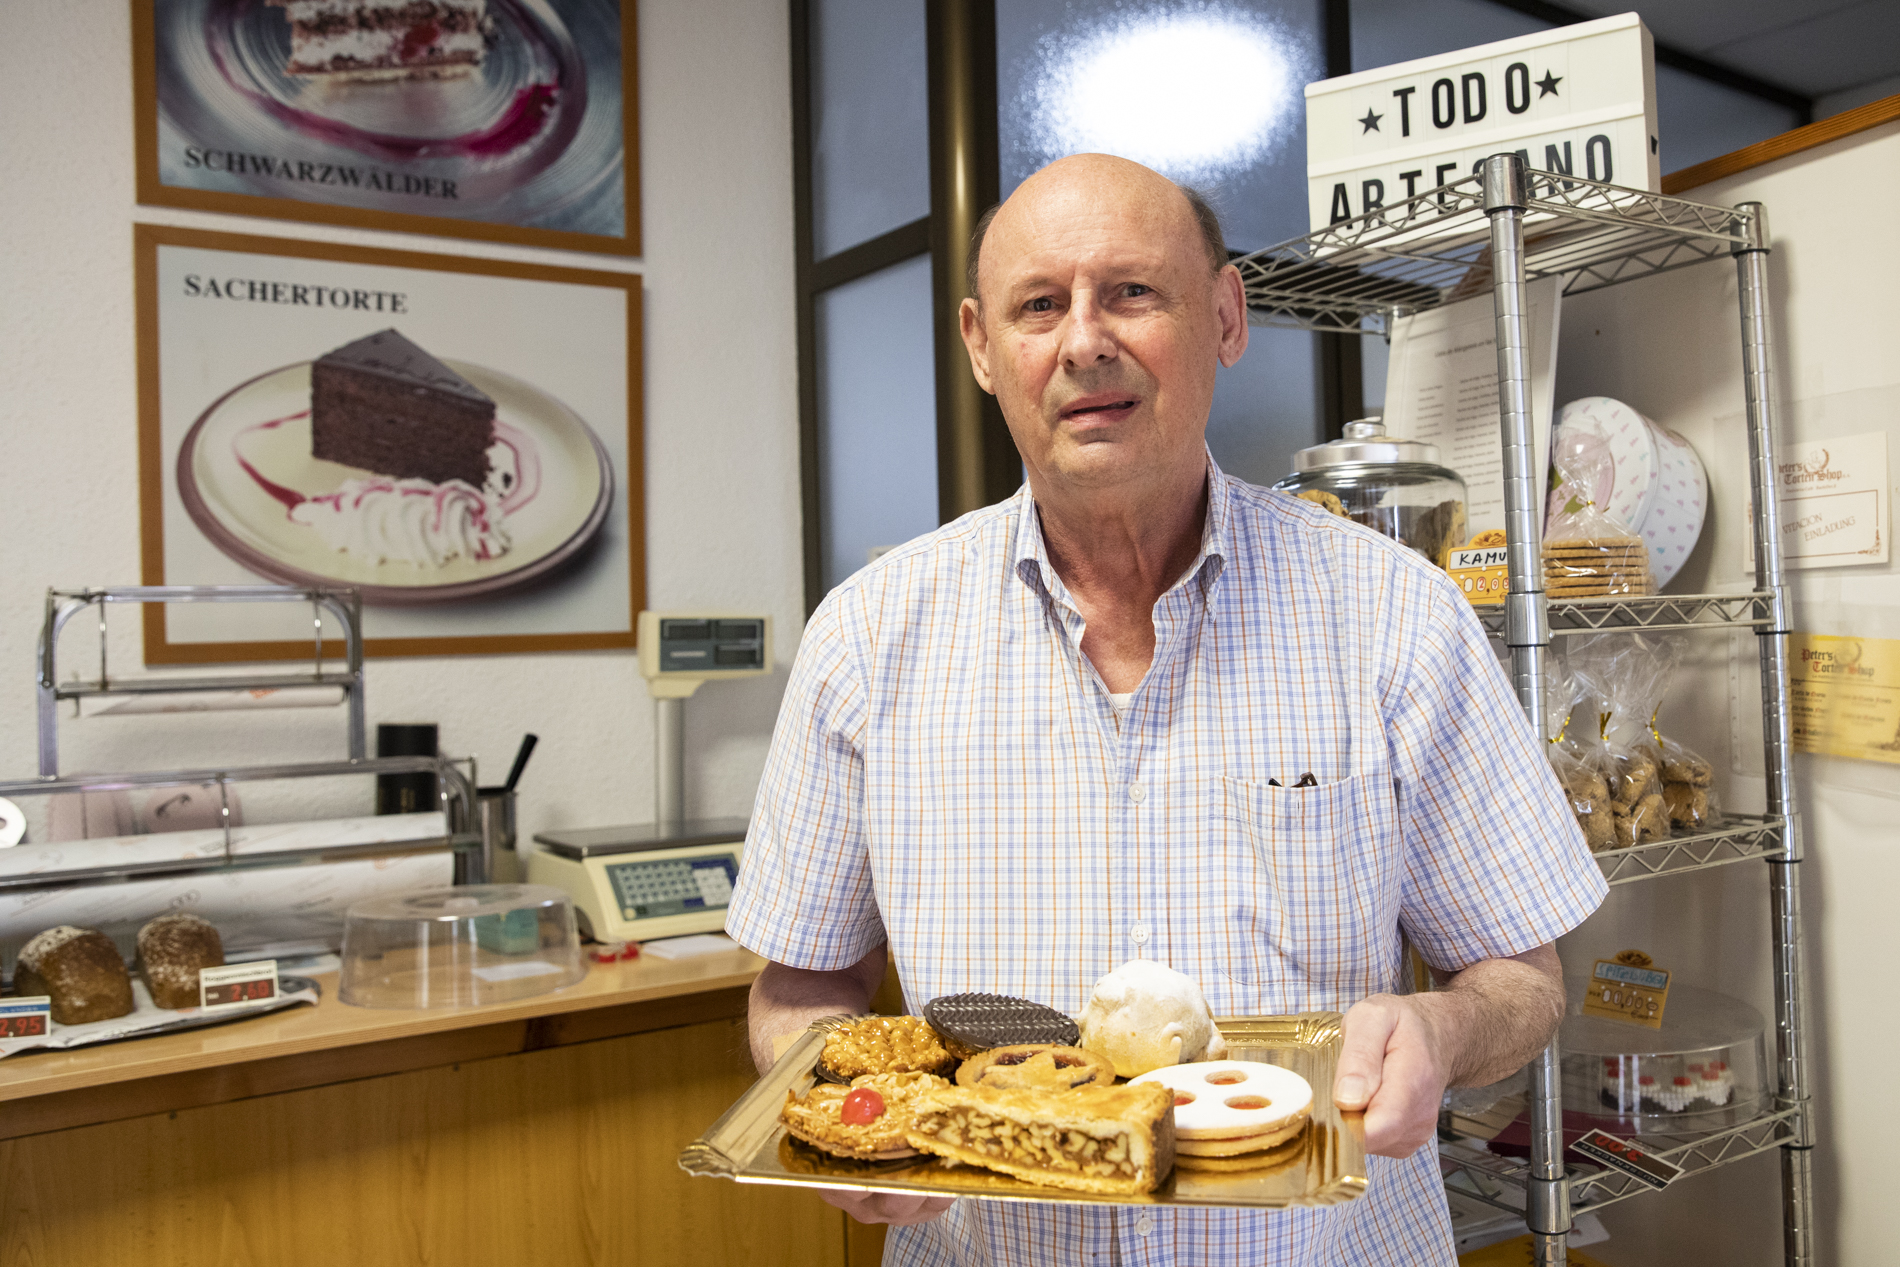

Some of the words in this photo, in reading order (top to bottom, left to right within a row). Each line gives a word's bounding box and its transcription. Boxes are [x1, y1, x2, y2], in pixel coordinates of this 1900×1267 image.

[1393, 62, 1530, 138] TODO
[184, 145, 459, 200] SCHWARZWÄLDER
[184, 273, 408, 314] SACHERTORTE
[1804, 515, 1856, 542] EINLADUNG
[1802, 648, 1833, 662] Peter's
